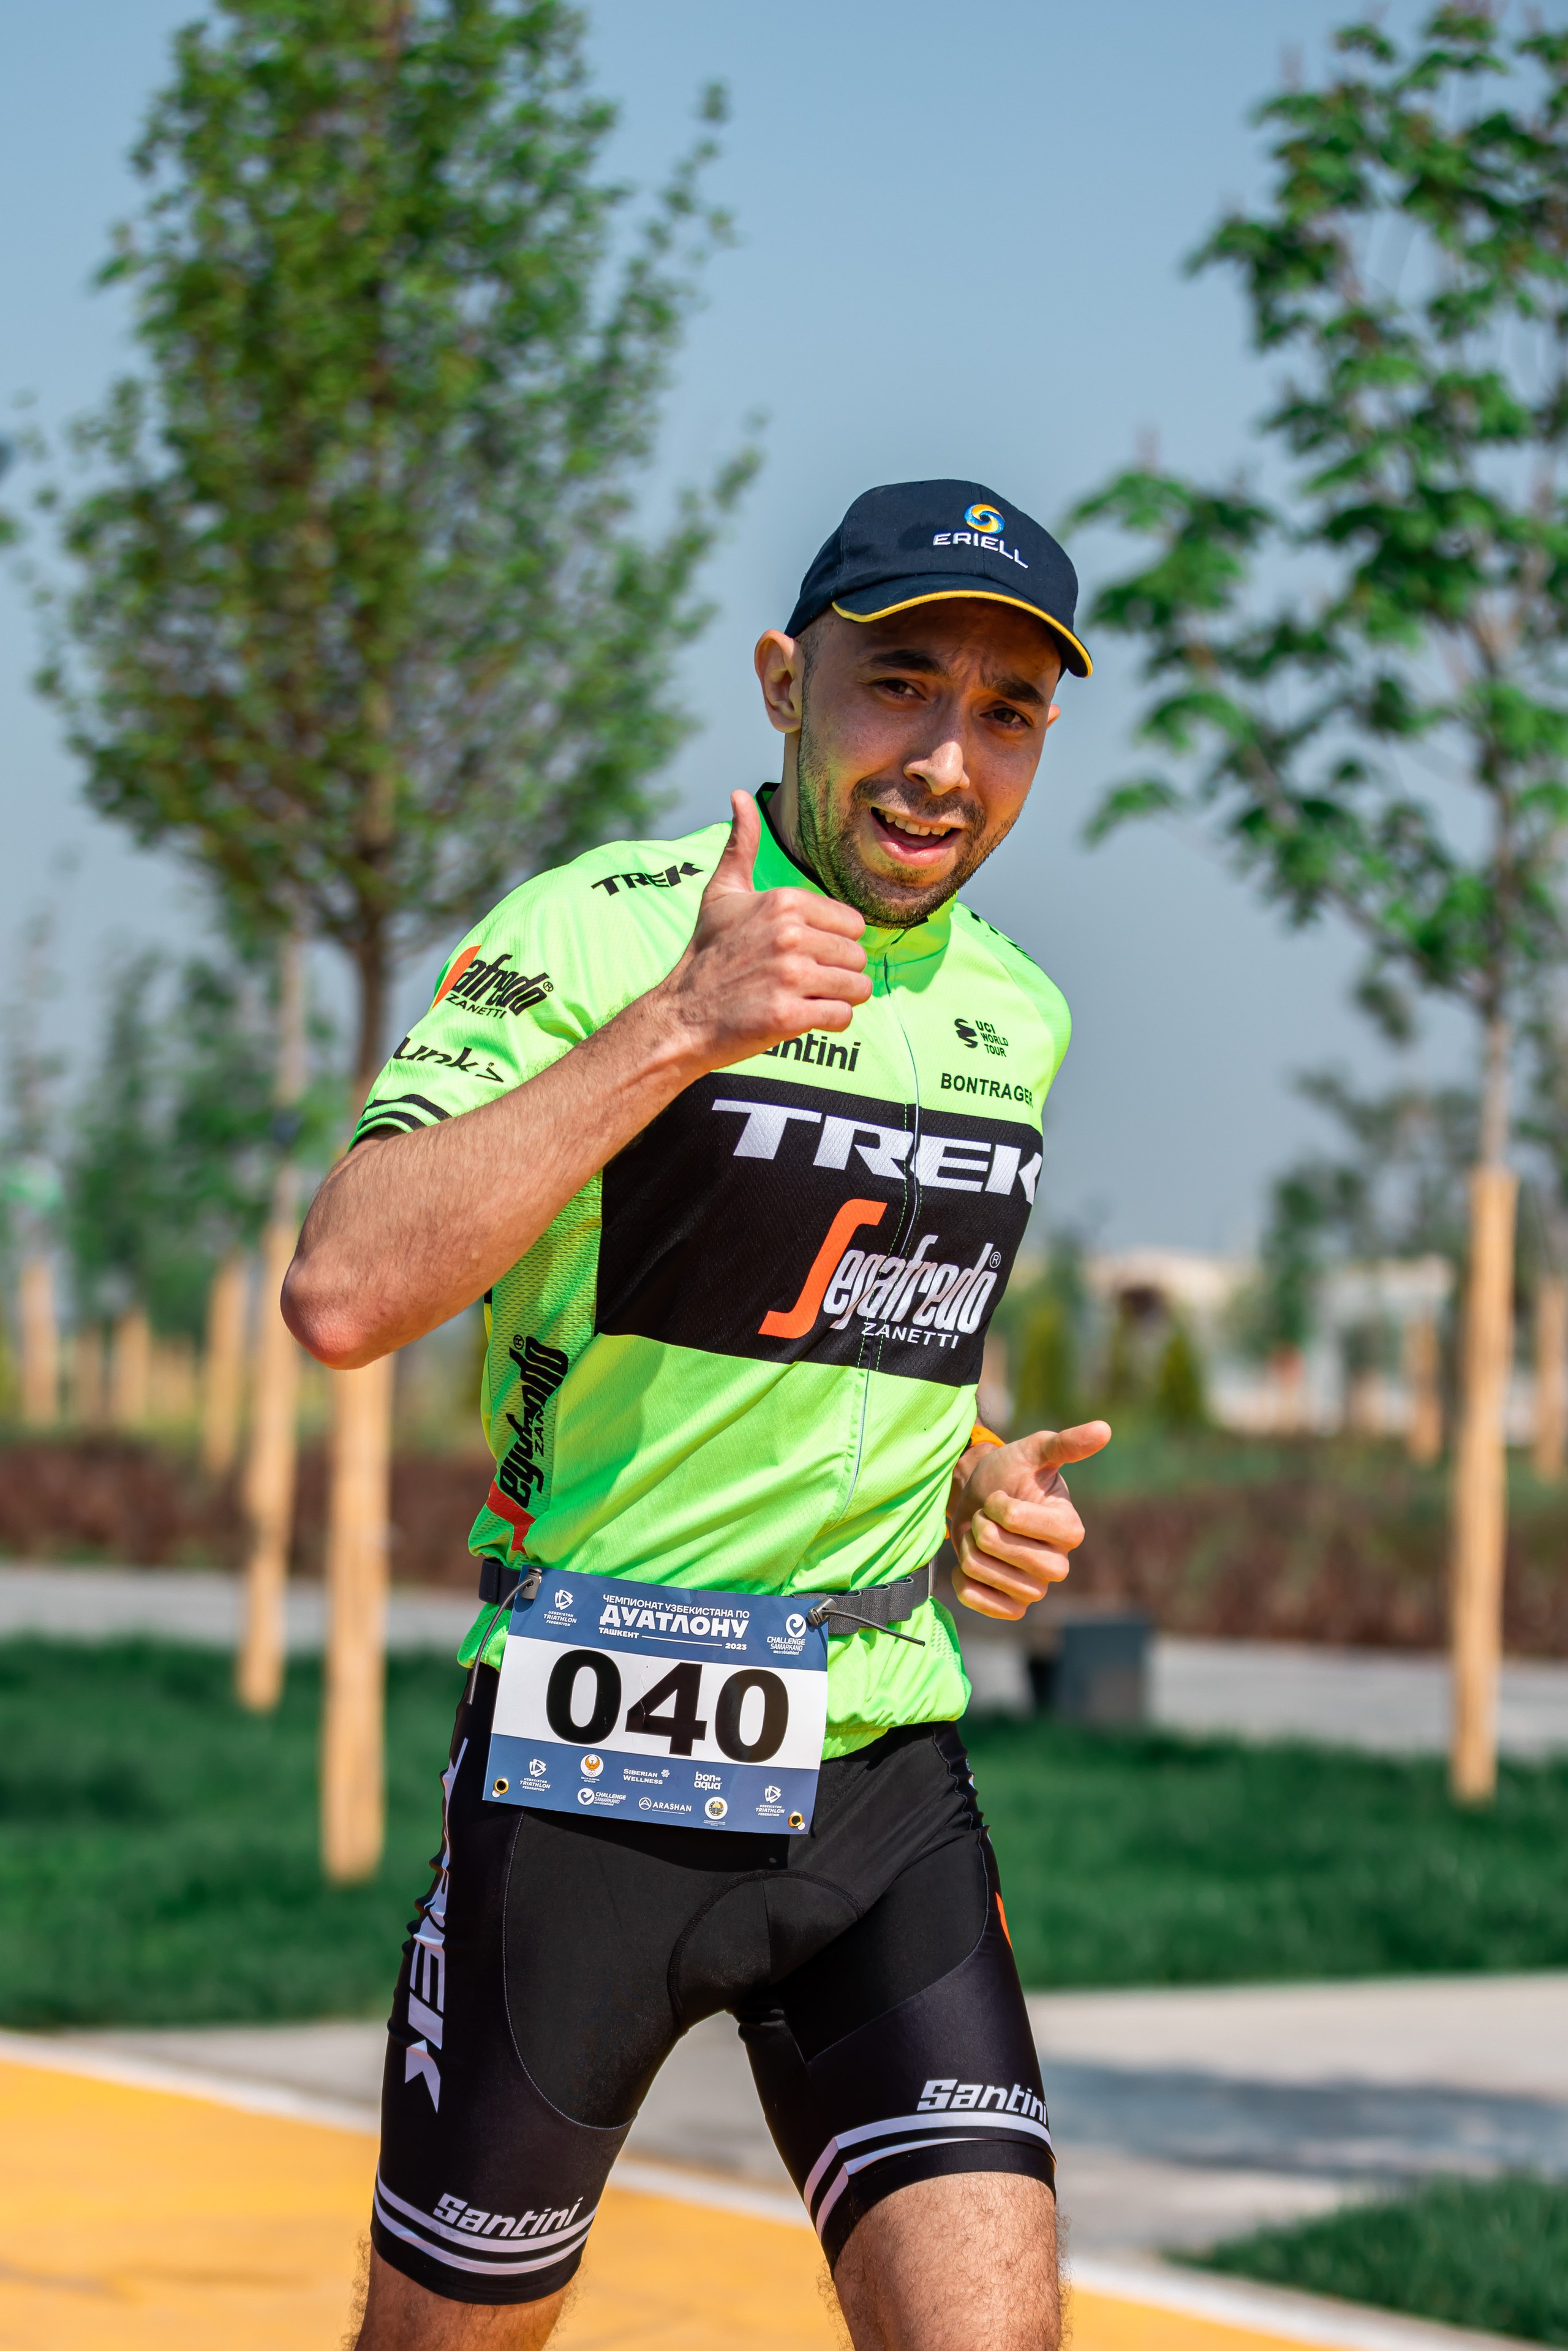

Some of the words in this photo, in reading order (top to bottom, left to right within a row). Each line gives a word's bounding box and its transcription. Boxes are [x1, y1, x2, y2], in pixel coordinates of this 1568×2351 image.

[933, 532, 1028, 569] ERIELL
[590, 862, 704, 896] TREK
[445, 993, 507, 1019] ZANETTI
[975, 1020, 996, 1034] UCI
[980, 1032, 1009, 1046] WORLD
[761, 1033, 861, 1072] ntini
[984, 1043, 1007, 1057] TOUR
[941, 1073, 1033, 1108] BONTRAGER
[712, 1099, 1042, 1206] TREK
[758, 1199, 997, 1340] Segafredo
[862, 1322, 959, 1349] ZANETTI
[543, 1613, 577, 1623] TRIATHLON
[603, 1594, 664, 1610] ЧЕМПИОНАТ
[666, 1602, 734, 1618] УЗБЕКИСТАНА
[736, 1610, 750, 1619] ПО
[599, 1604, 750, 1639] ДУАТЛОНУ
[598, 1627, 639, 1639] ТАШКЕНТ
[725, 1642, 747, 1651] 2023
[766, 1636, 805, 1645] CHALLENGE
[770, 1643, 803, 1651] SAMARKAND
[546, 1649, 789, 1763] 040
[519, 1780, 551, 1789] TRIATHLON
[623, 1768, 658, 1778] SIBERIAN
[623, 1775, 663, 1785] WELLNESS
[695, 1771, 715, 1783] bon
[595, 1792, 627, 1800] CHALLENGE
[693, 1780, 721, 1791] aqua
[652, 1802, 692, 1813] ARASHAN
[917, 2079, 1047, 2126] Santini
[432, 2193, 584, 2237] Santini
